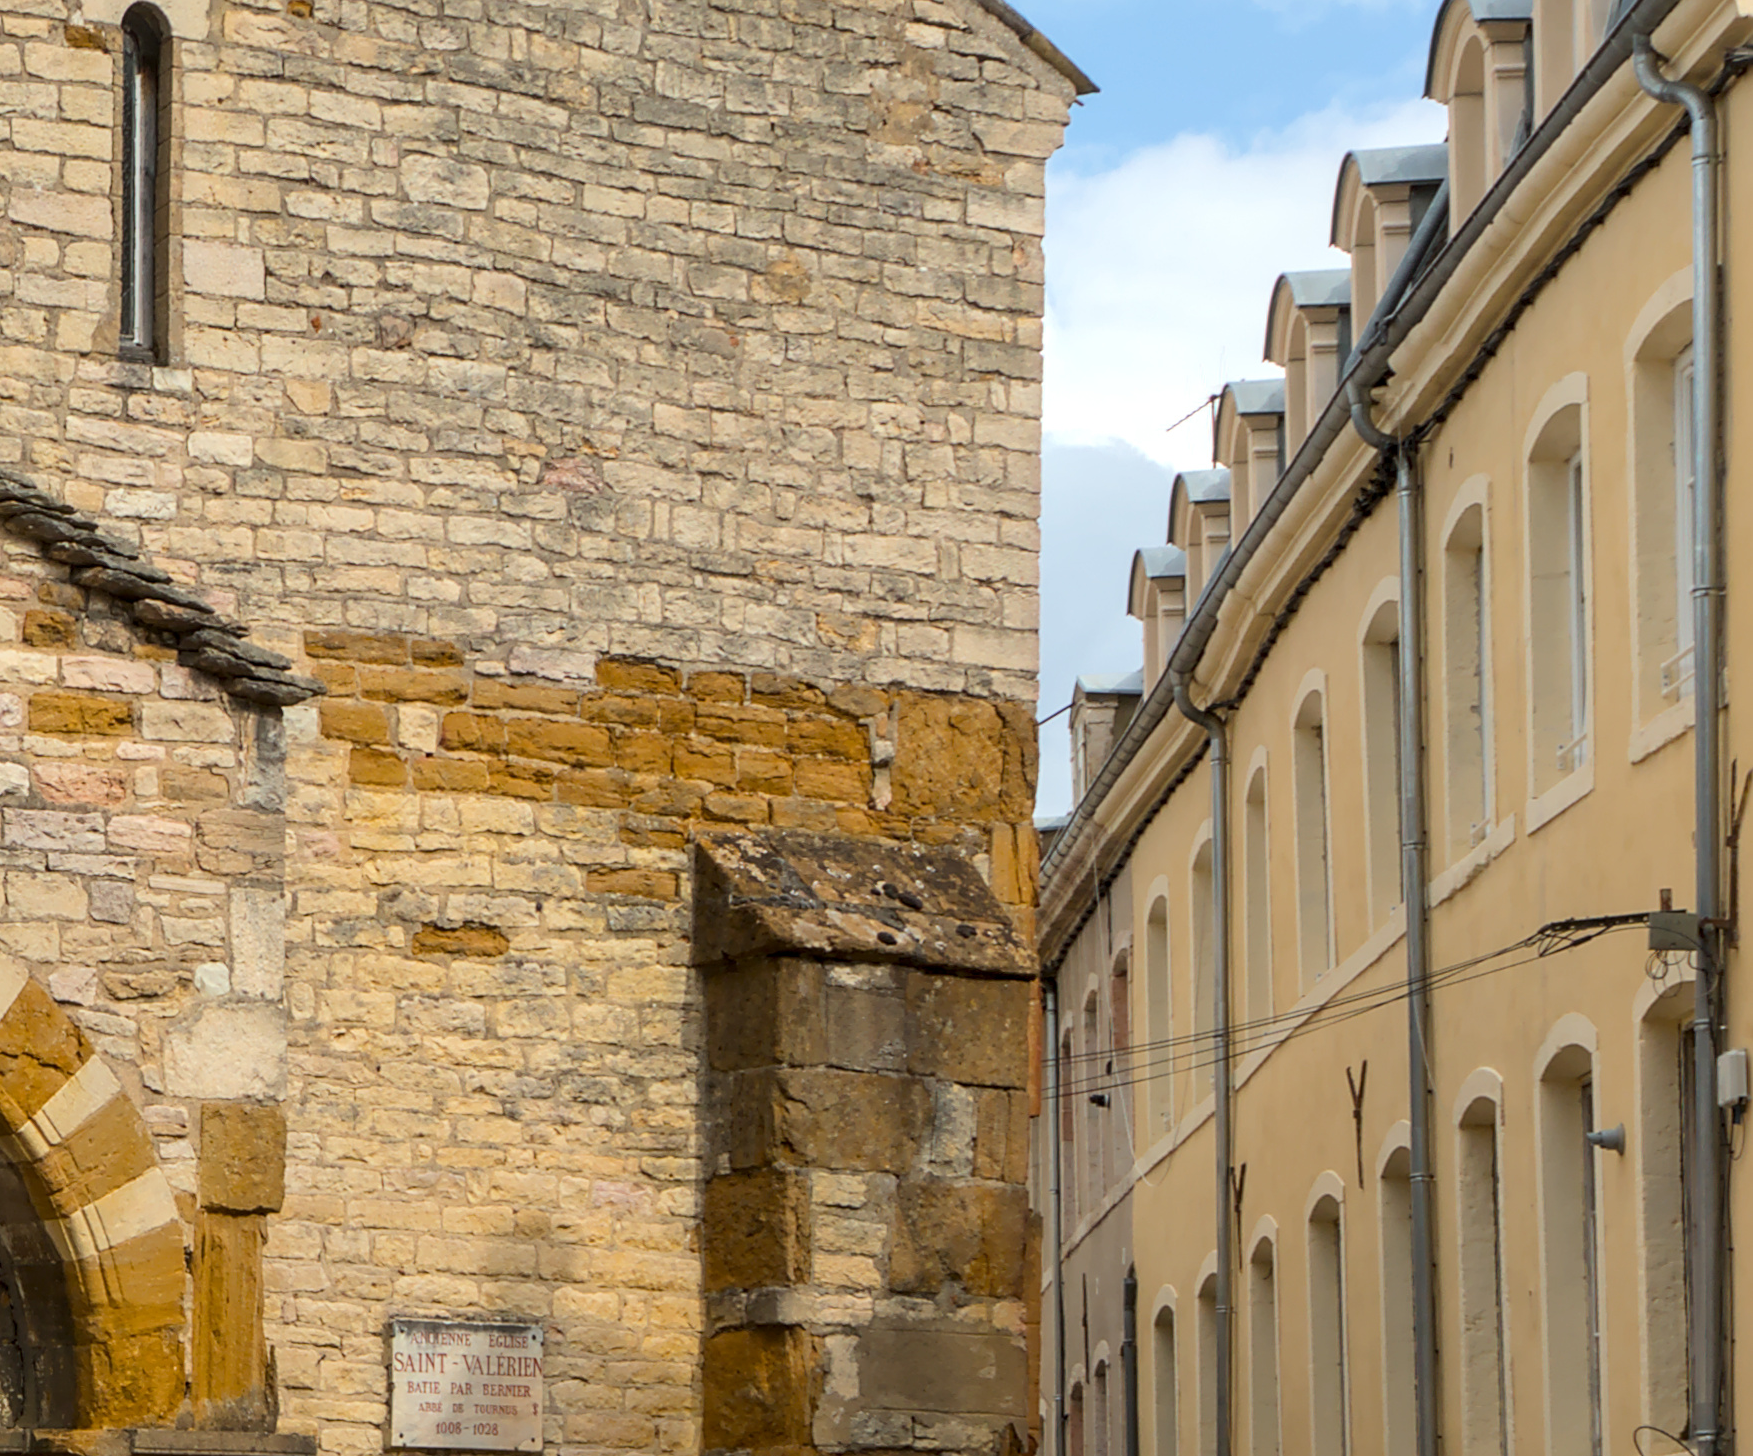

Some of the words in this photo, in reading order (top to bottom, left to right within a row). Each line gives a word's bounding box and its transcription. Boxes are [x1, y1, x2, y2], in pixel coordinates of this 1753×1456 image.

[407, 1380, 441, 1395] BATIE
[450, 1382, 473, 1395] PAR
[482, 1383, 532, 1398] BERNIER
[452, 1403, 464, 1414] DE
[473, 1404, 518, 1416] TOURNUS
